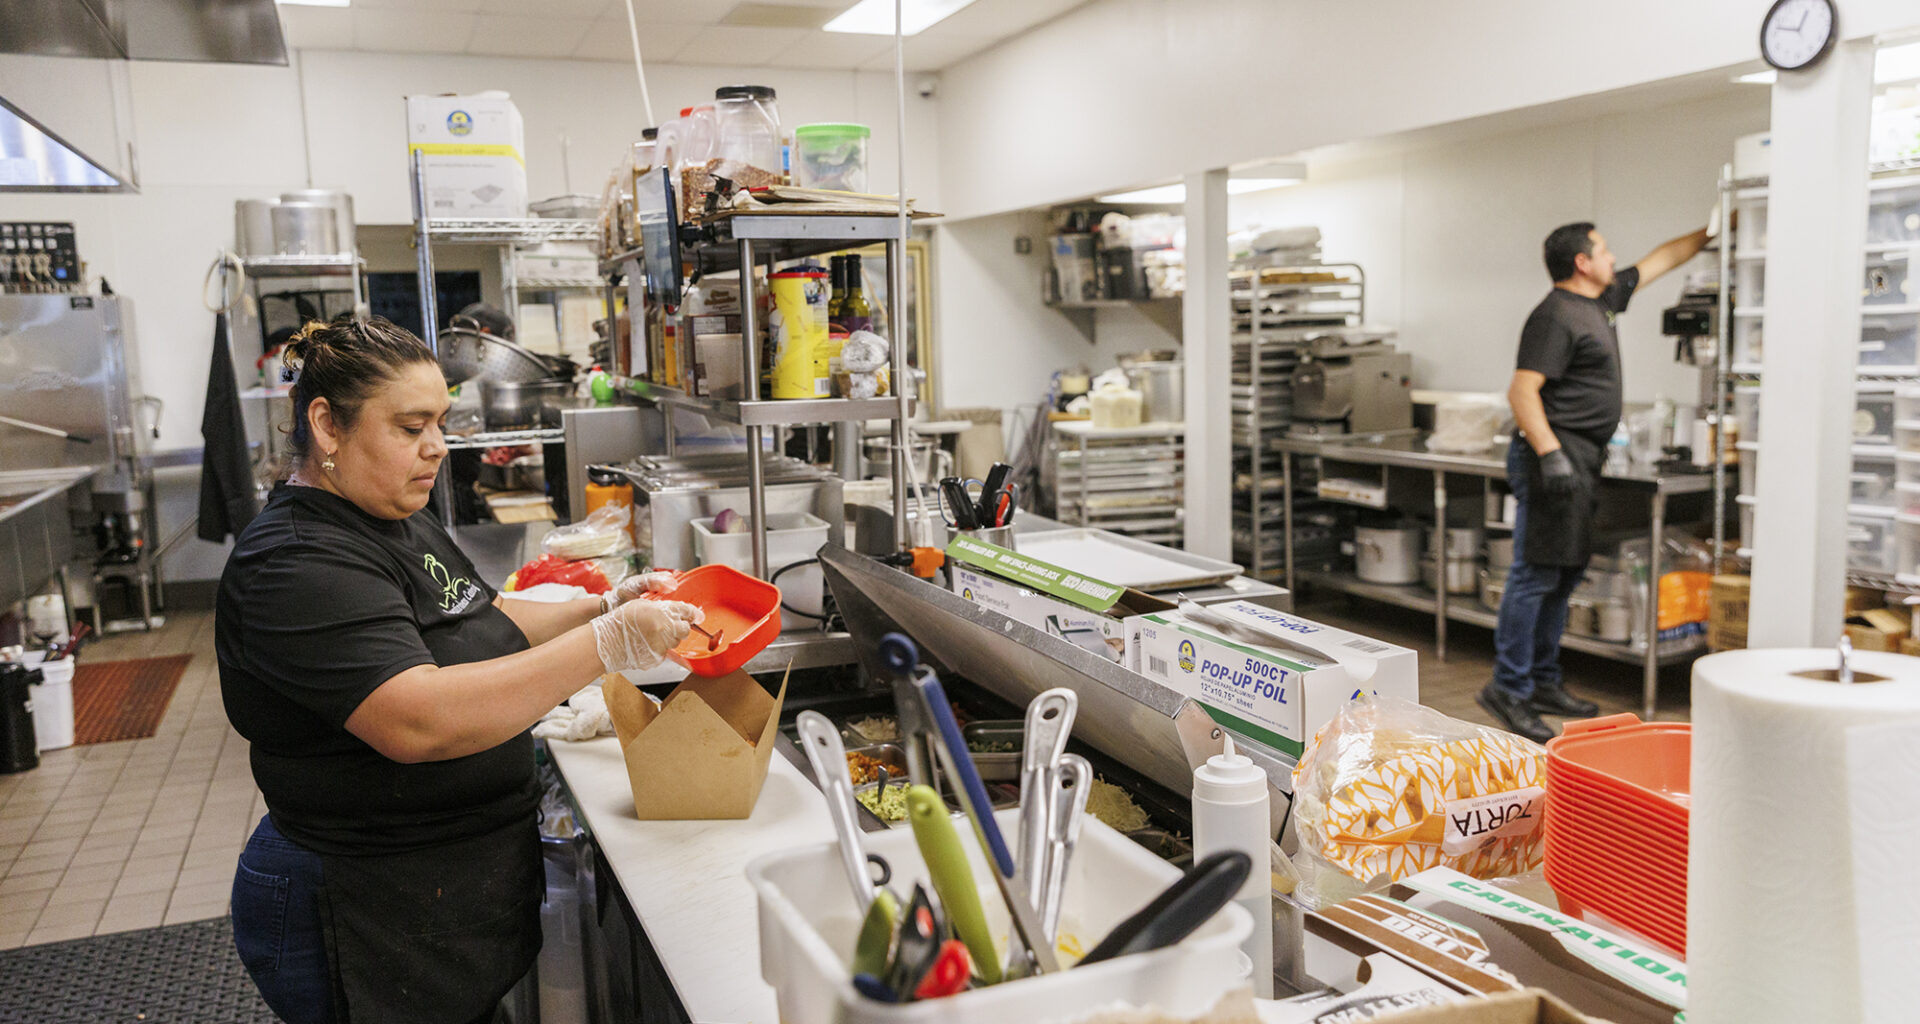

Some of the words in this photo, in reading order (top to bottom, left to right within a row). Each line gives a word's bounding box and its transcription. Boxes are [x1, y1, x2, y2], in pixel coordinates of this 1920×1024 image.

[1060, 574, 1082, 589] ECO
[1075, 579, 1118, 601] FRIENDLY
[1201, 659, 1253, 689] POP-UP
[1253, 679, 1288, 705] FOIL
[1244, 657, 1289, 684] 500CT
[1236, 698, 1253, 710] sheet
[1452, 799, 1532, 837] TORTA
[1381, 915, 1459, 953] DELI
